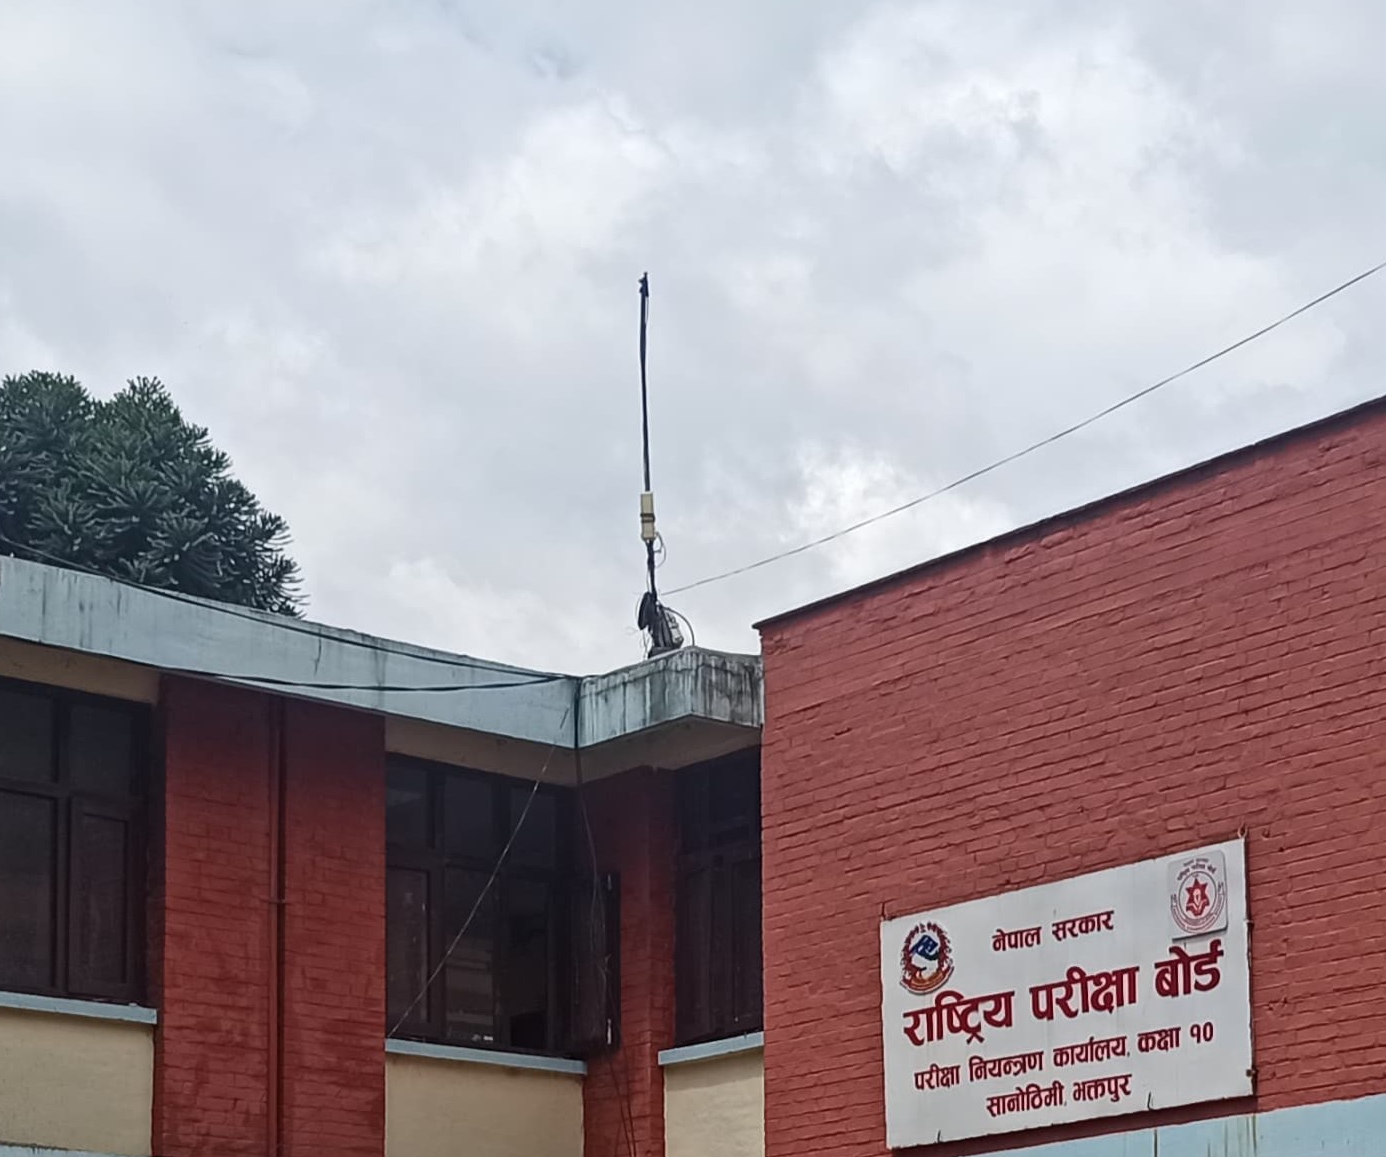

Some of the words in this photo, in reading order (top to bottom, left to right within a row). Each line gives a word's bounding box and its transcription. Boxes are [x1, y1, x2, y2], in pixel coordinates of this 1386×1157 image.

[992, 927, 1042, 952] नेपाल
[1052, 910, 1114, 942] सरकार
[903, 990, 1016, 1046] राष्ट्रिय
[1029, 966, 1140, 1020] परीक्षा
[1154, 938, 1225, 998] बोर्ड
[914, 1063, 961, 1090] परीक्षा
[969, 1051, 1045, 1083] नियन्त्रण
[1138, 1027, 1181, 1053] कक्षा
[1190, 1022, 1214, 1044] १०
[1073, 1074, 1132, 1102] भक्तपुर
